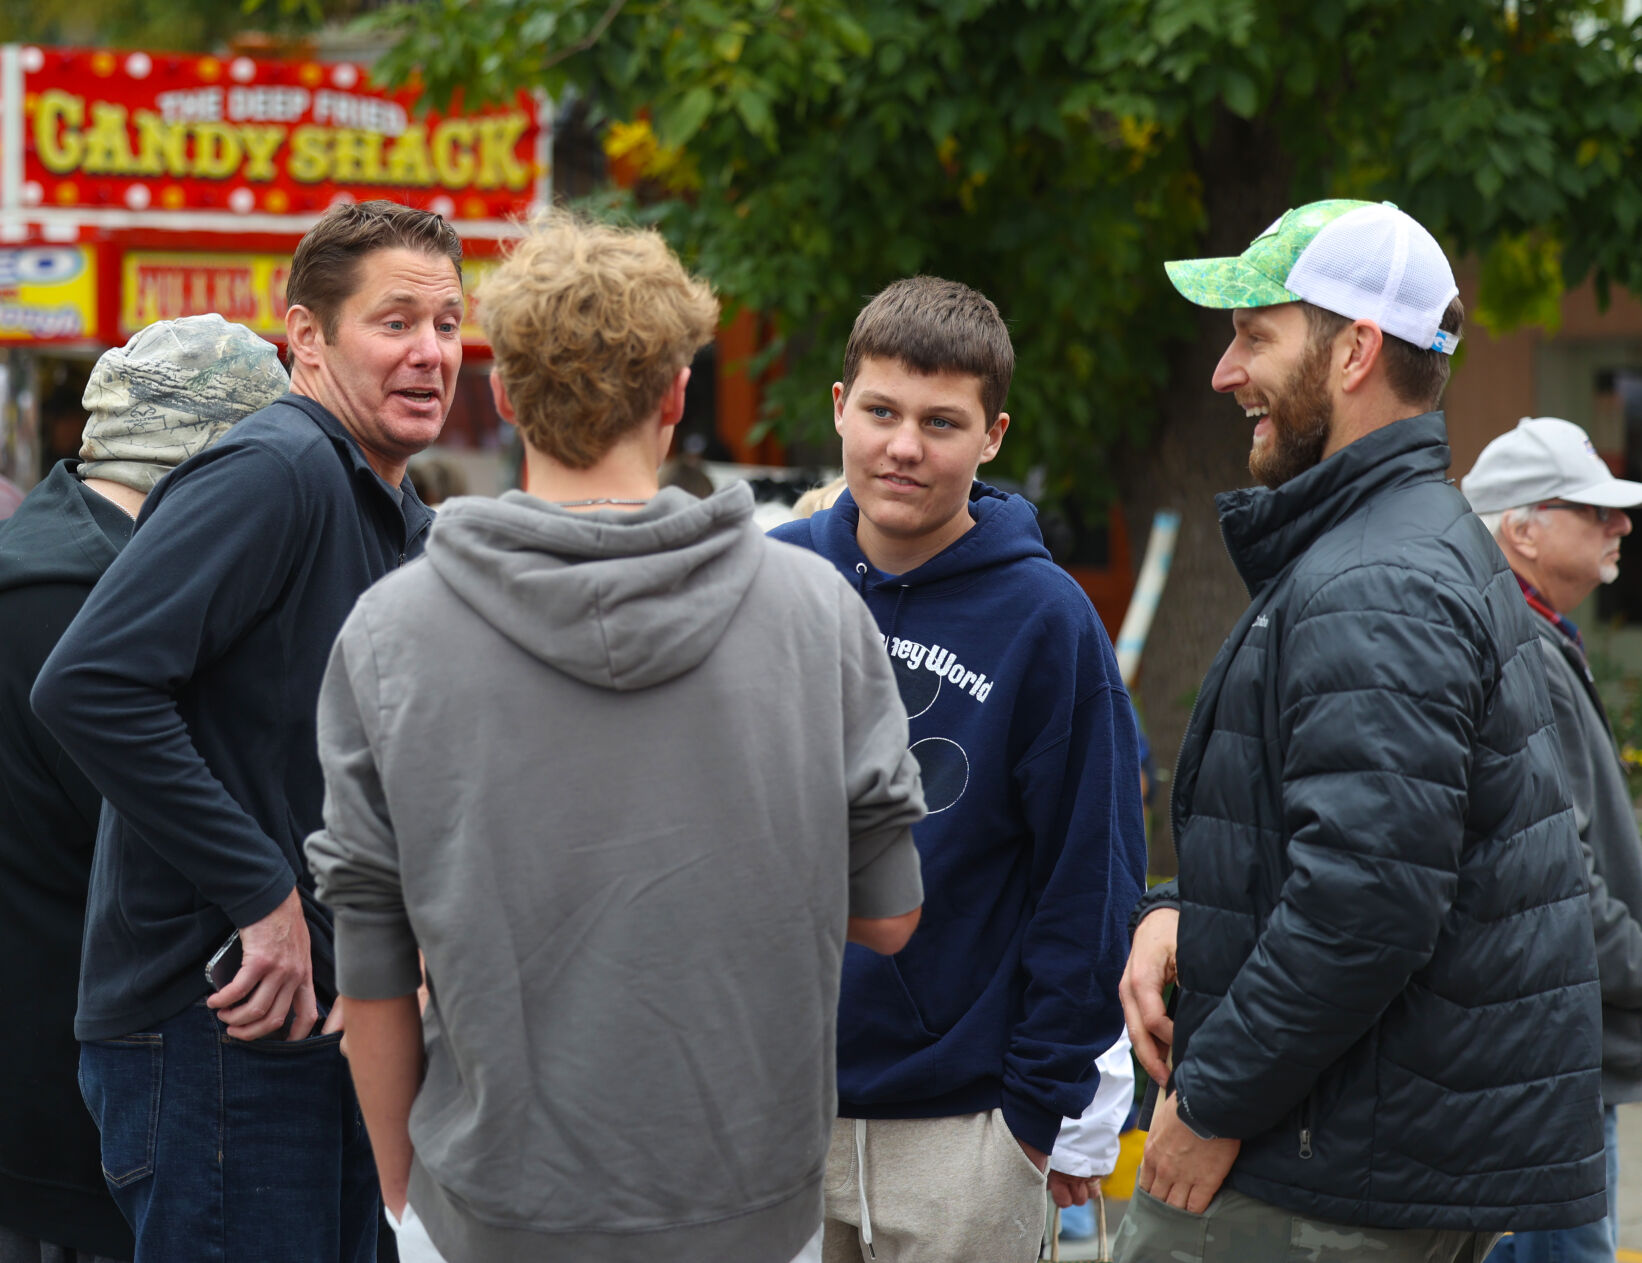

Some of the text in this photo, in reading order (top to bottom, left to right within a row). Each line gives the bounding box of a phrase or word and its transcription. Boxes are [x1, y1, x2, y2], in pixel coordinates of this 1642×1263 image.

[36, 89, 529, 189] CANDY SHACK
[158, 86, 407, 136] THE DEEP FRIED
